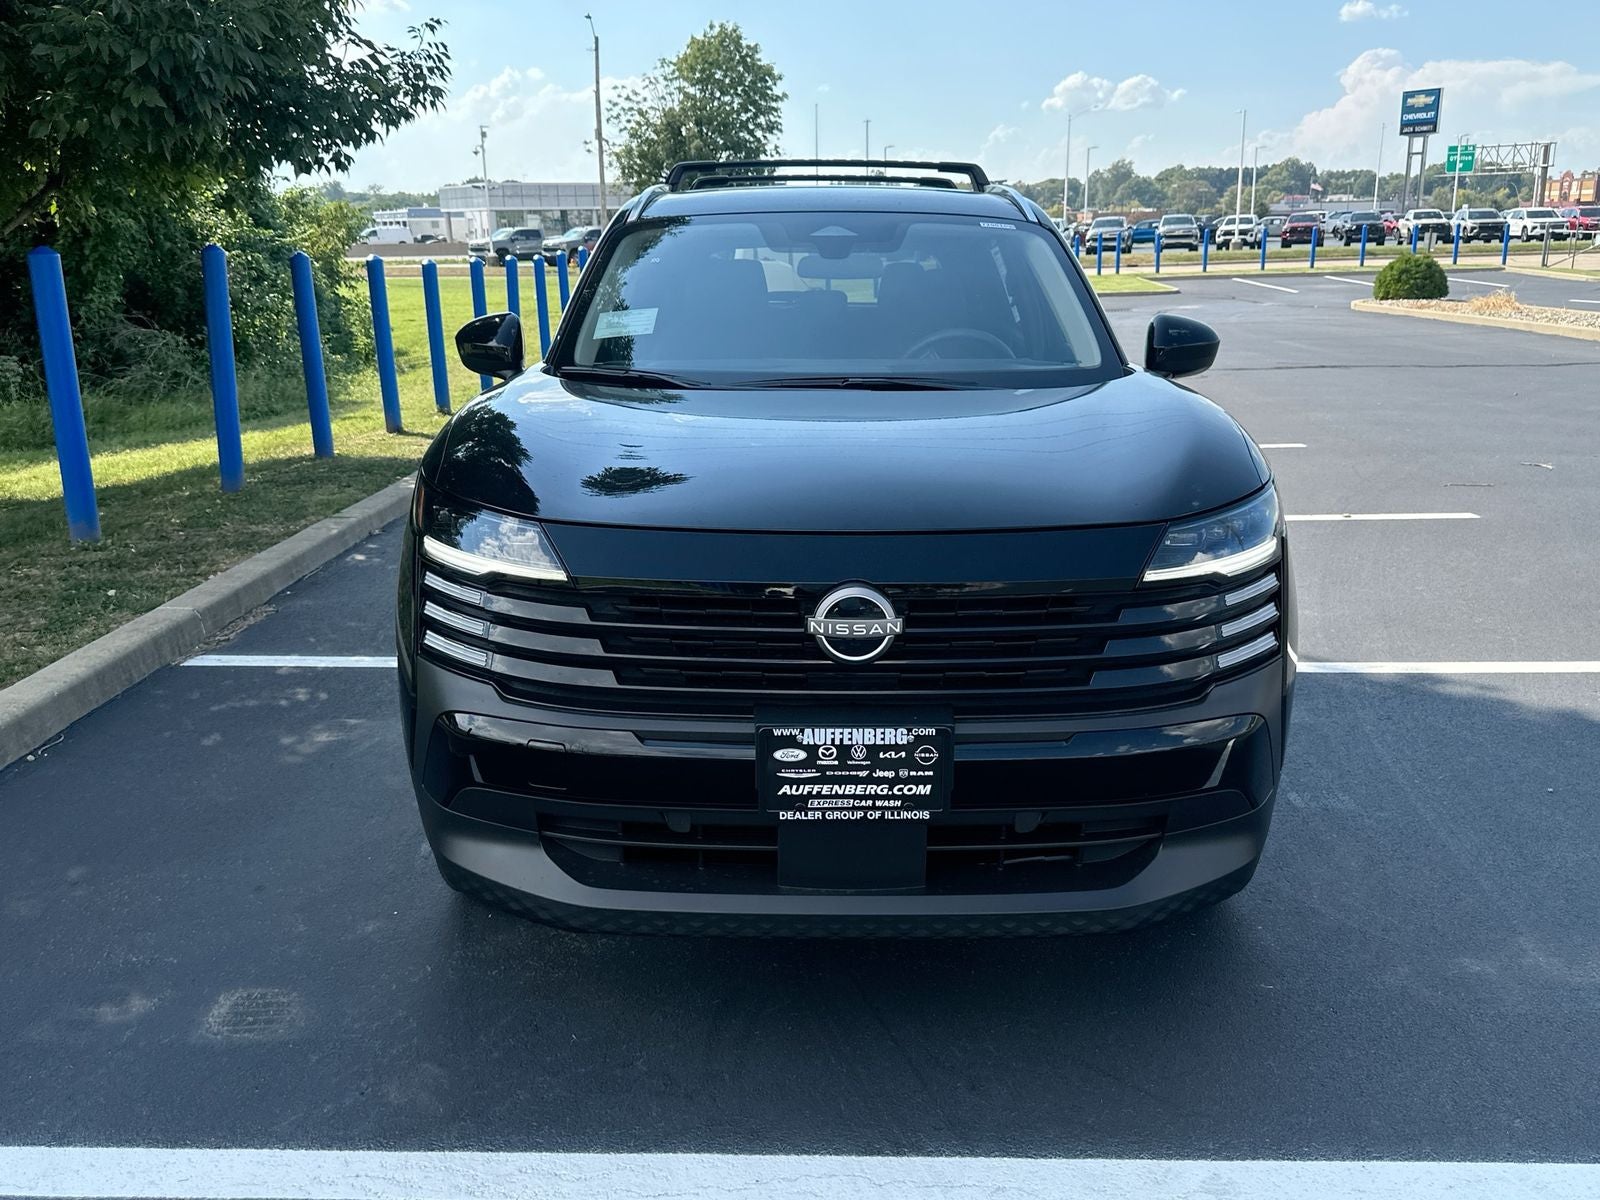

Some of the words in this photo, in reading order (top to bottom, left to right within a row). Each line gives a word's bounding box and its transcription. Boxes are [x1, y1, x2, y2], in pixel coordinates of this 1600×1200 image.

[1403, 112, 1435, 120] CHEVROLET
[810, 621, 900, 635] NISSAN
[780, 751, 800, 759] Ford
[872, 769, 895, 778] Jeep
[777, 784, 932, 795] AUFFENBERG.COM
[779, 811, 822, 820] DEALER
[825, 811, 864, 820] GROUP
[867, 811, 882, 820] OF
[884, 811, 930, 820] ILLINOIS
